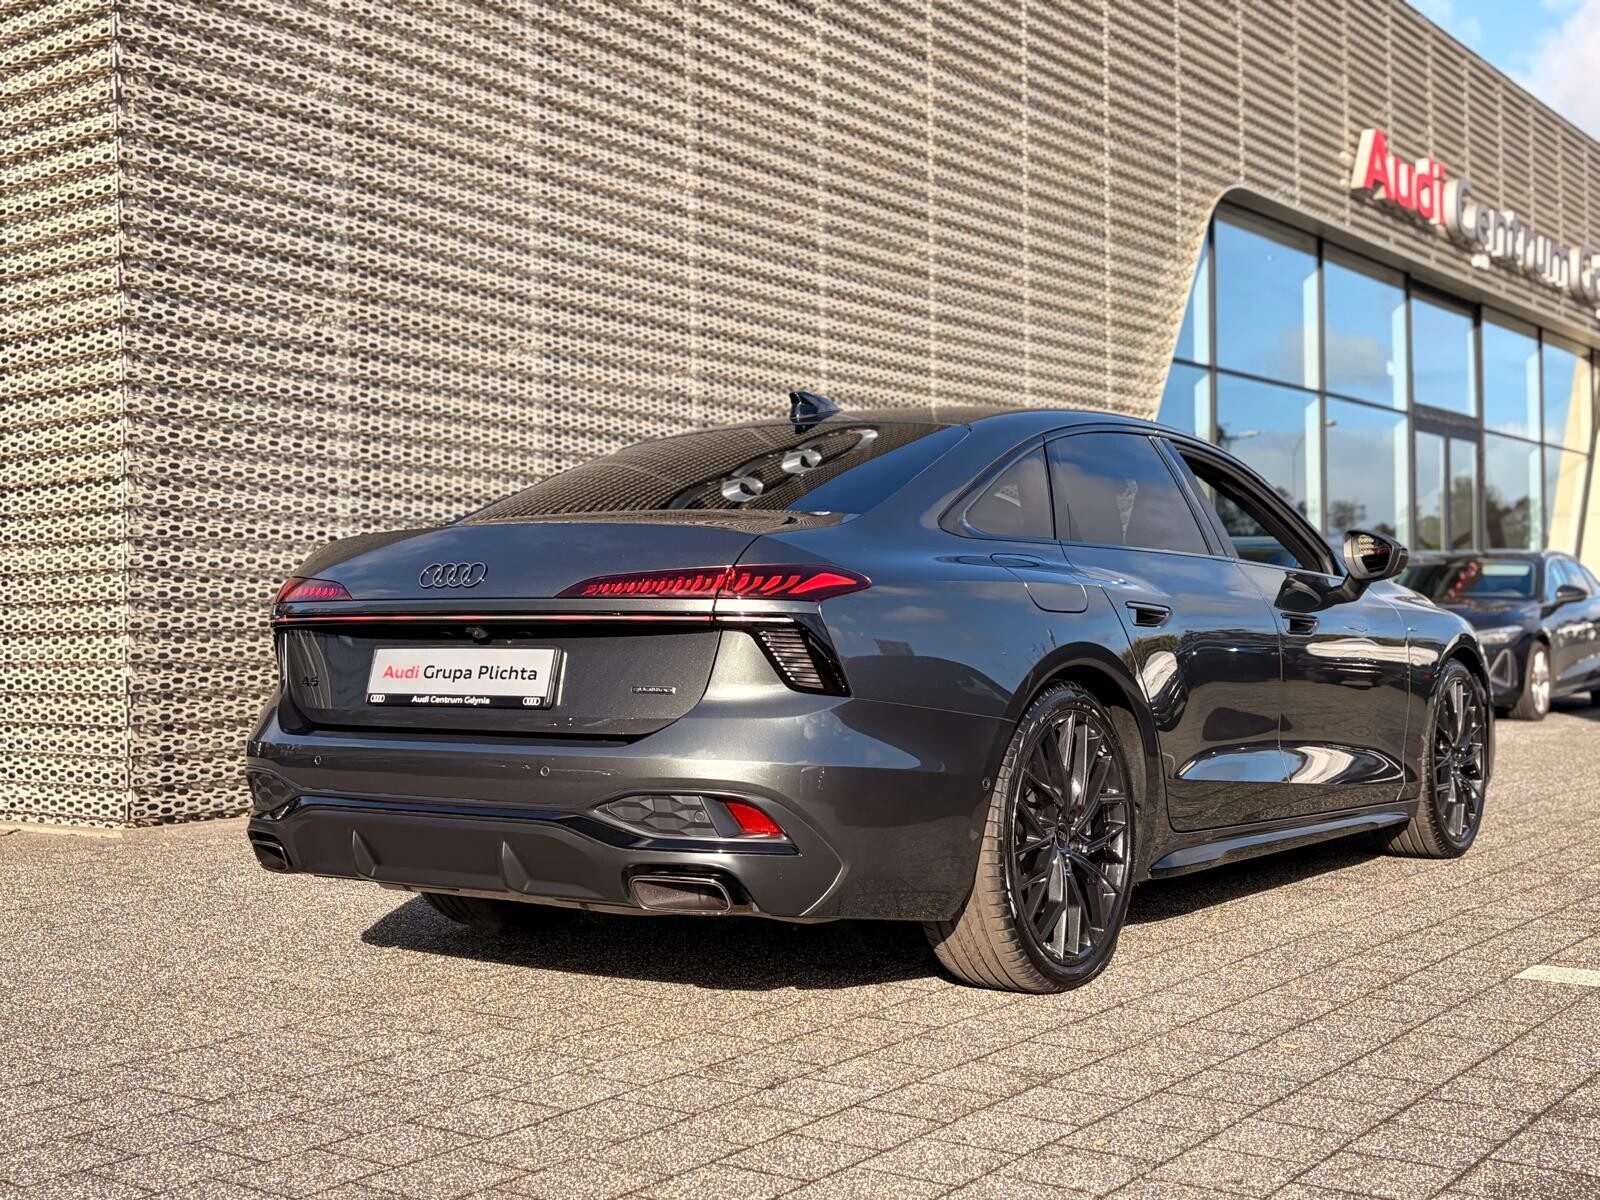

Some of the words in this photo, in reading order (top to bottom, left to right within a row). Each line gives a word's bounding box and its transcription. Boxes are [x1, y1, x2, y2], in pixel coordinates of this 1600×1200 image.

[1352, 128, 1448, 224] Audi
[1444, 177, 1569, 288] Centrum
[1567, 245, 1600, 303] G
[383, 666, 420, 679] Audi
[423, 665, 473, 683] Grupa
[477, 666, 538, 680] Plichta
[411, 695, 429, 703] Audi
[430, 696, 463, 704] Centrum
[464, 696, 490, 706] Gdynia
